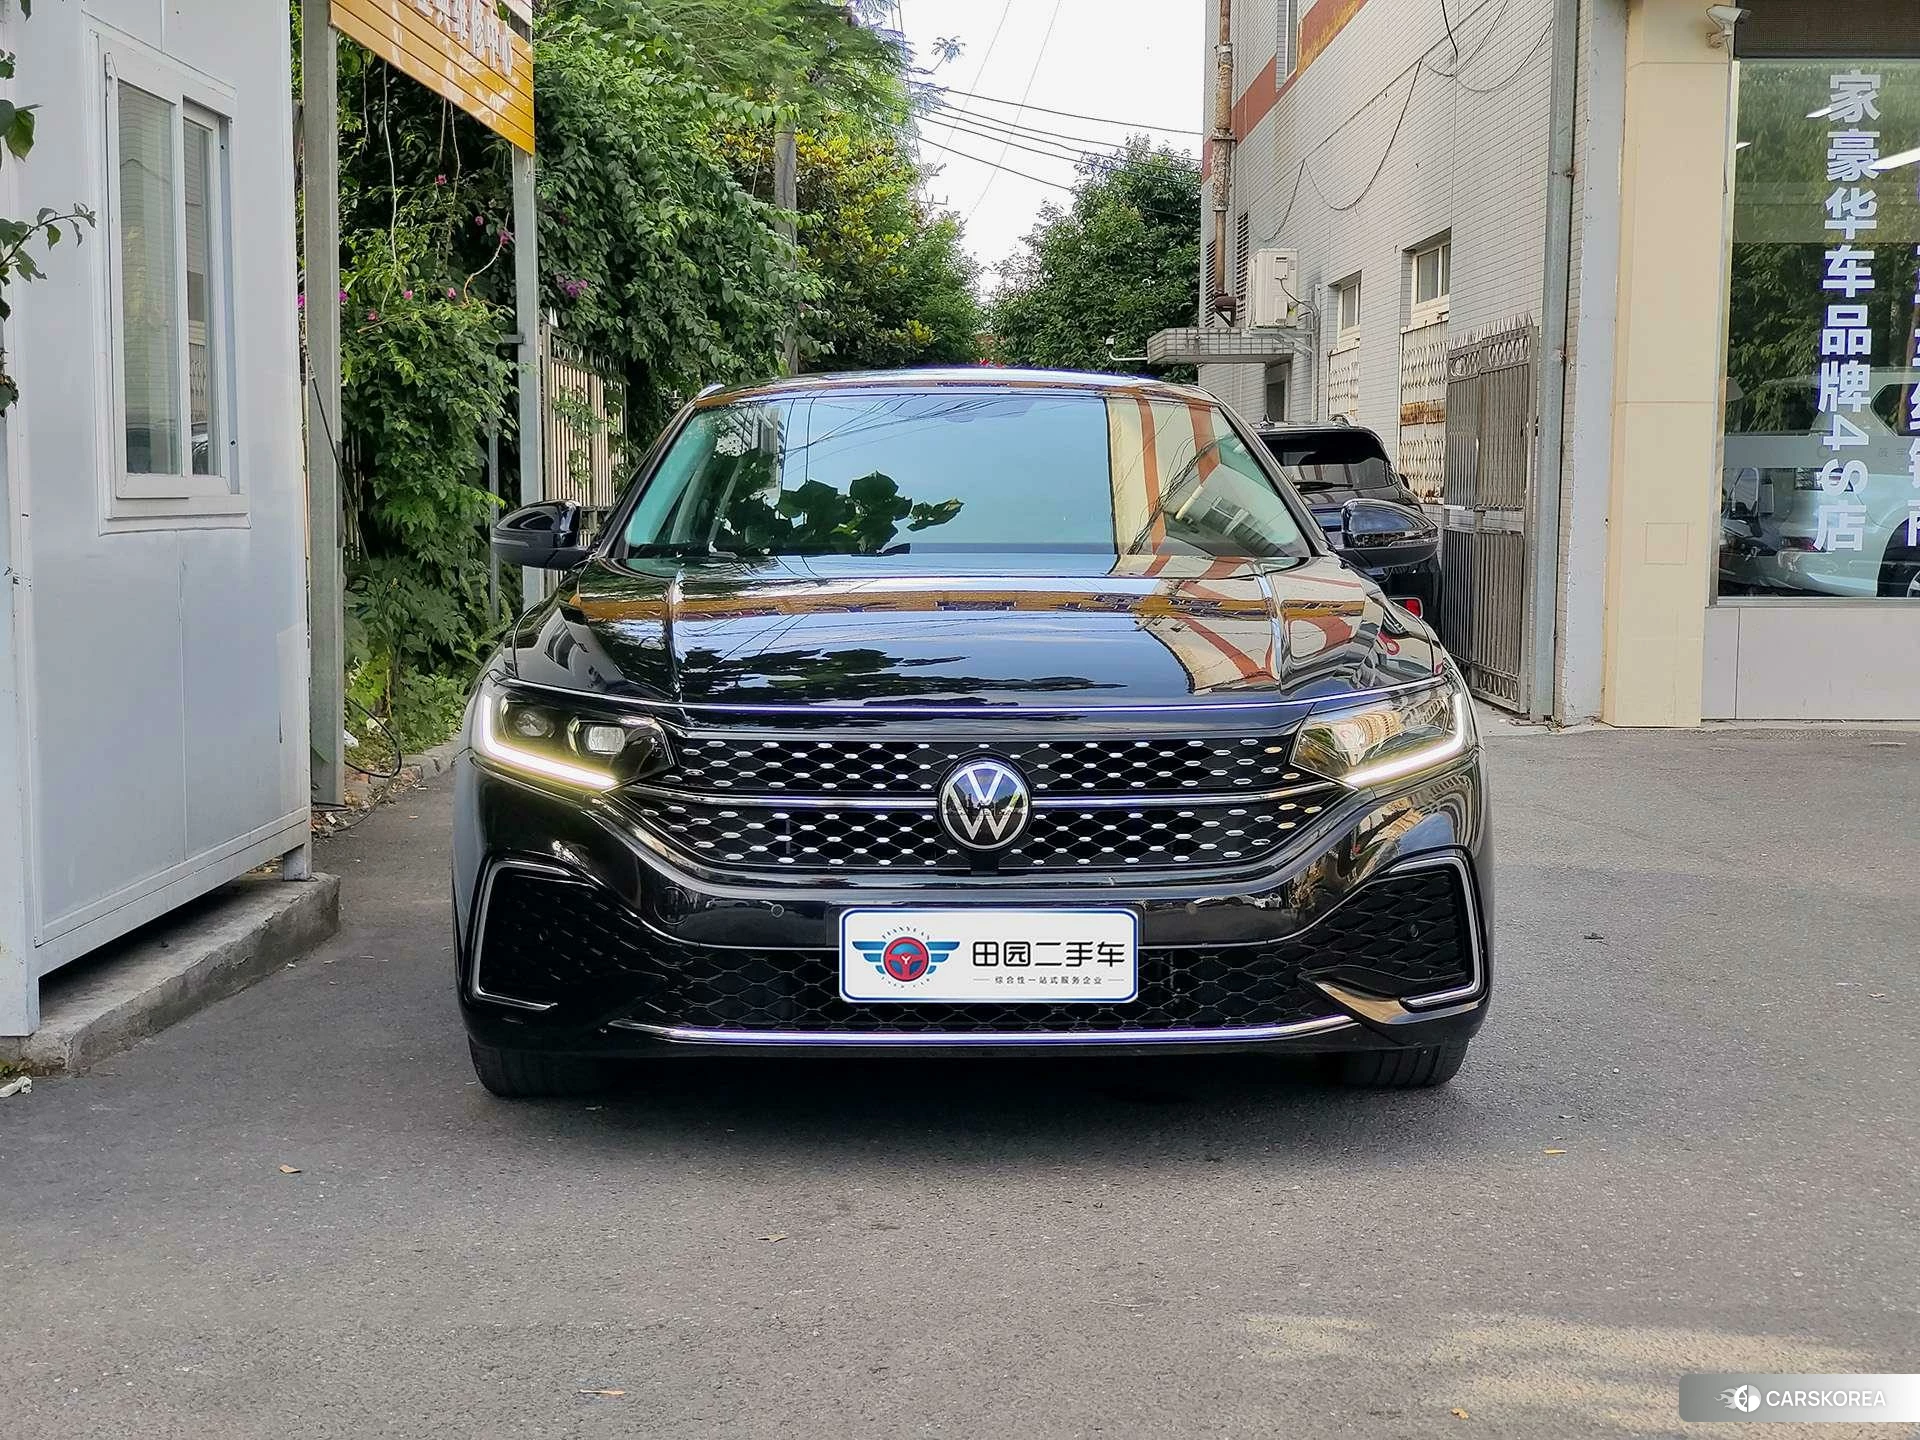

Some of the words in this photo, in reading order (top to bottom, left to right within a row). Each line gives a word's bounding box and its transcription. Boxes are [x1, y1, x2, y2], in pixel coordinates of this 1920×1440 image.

[1813, 70, 1881, 550] 家豪华车品牌4S店
[946, 765, 1023, 842] VW
[972, 941, 1125, 967] 田园二手车
[994, 975, 1103, 985] 综合性一站式服务企业
